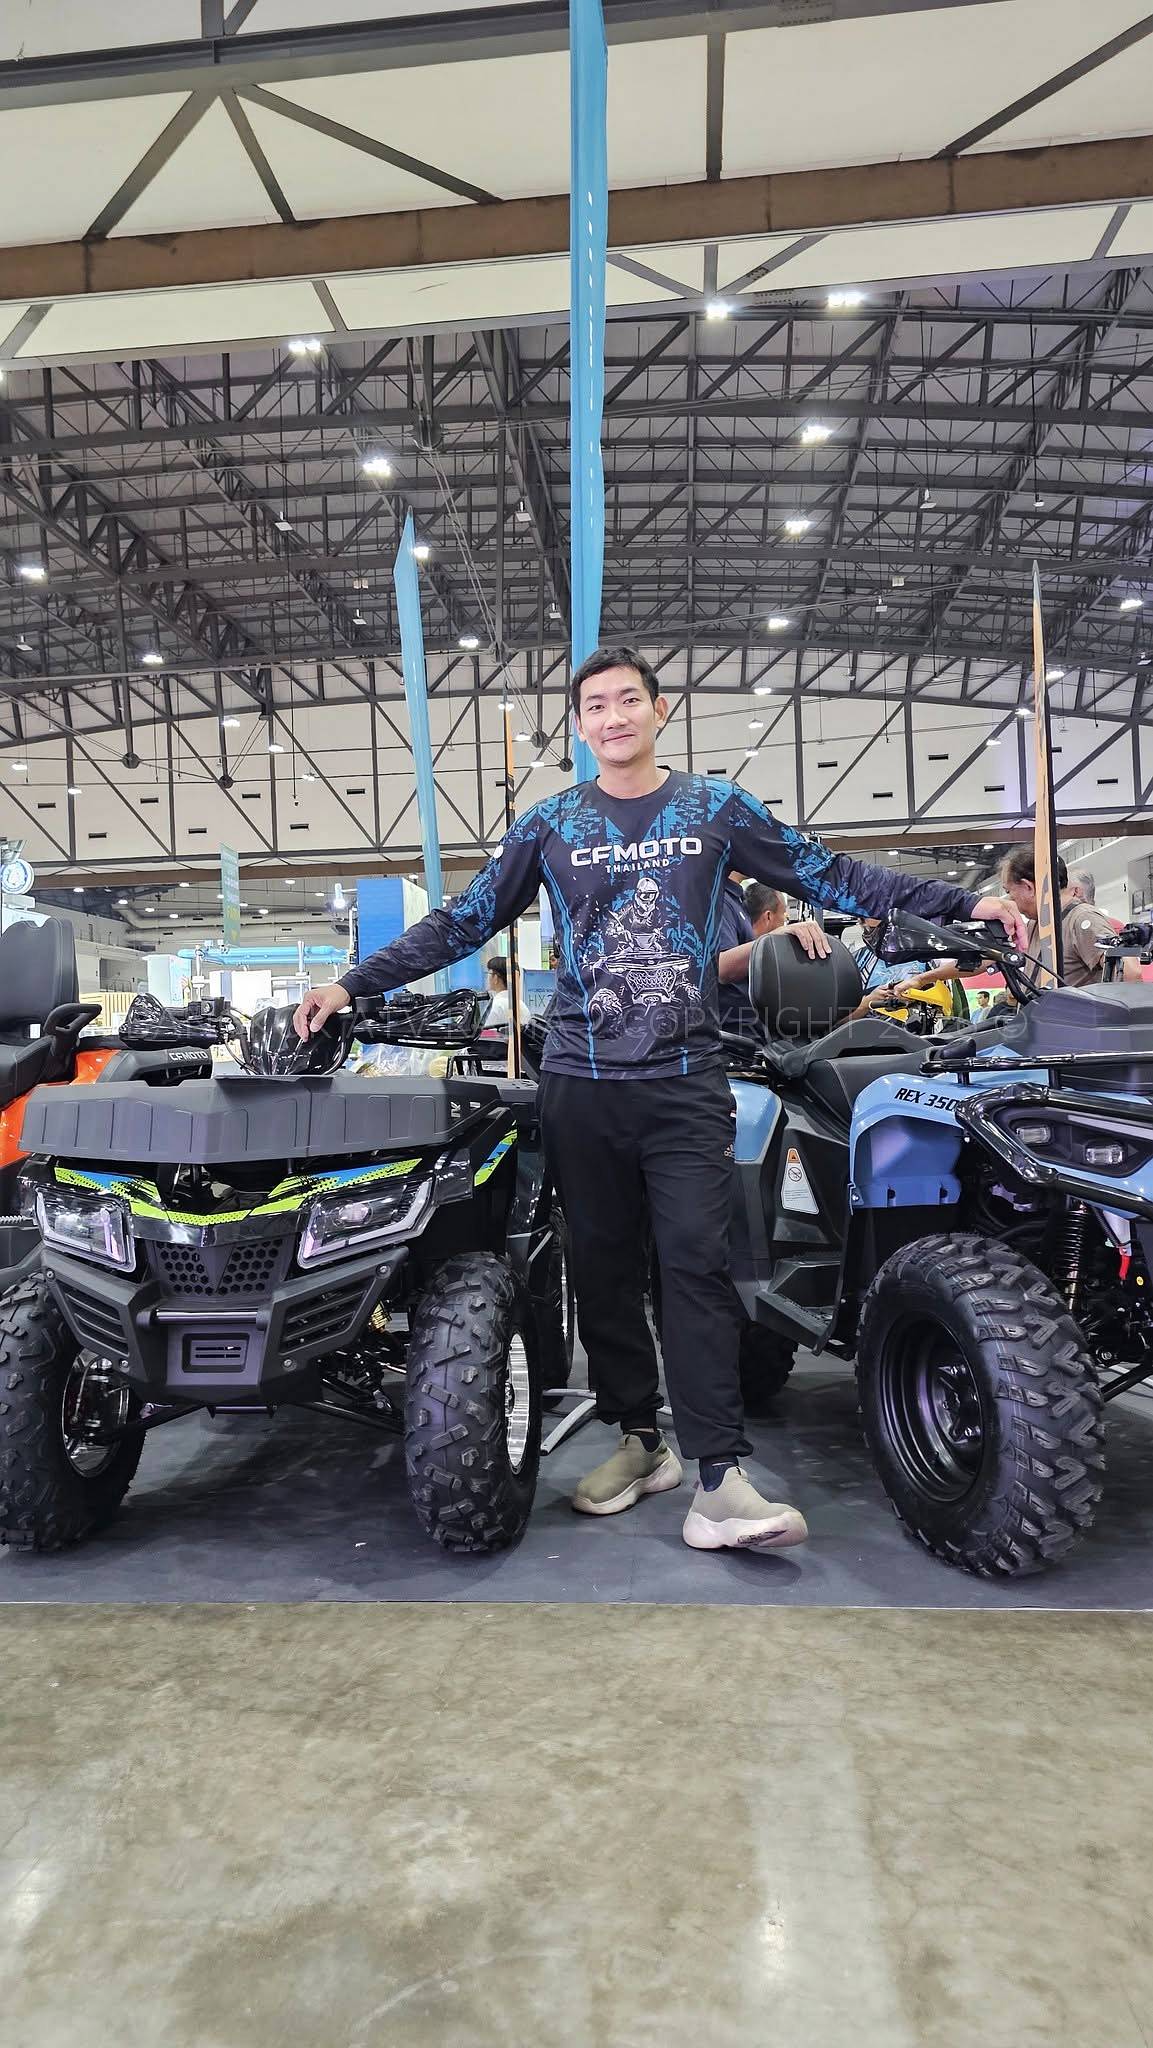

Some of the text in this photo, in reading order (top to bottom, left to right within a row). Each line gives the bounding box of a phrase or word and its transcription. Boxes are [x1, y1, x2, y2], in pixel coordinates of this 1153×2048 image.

[570, 837, 702, 867] CFMOTO
[605, 858, 670, 874] THAILAND
[168, 1051, 209, 1061] CFMOTO
[894, 1087, 960, 1112] REX 350
